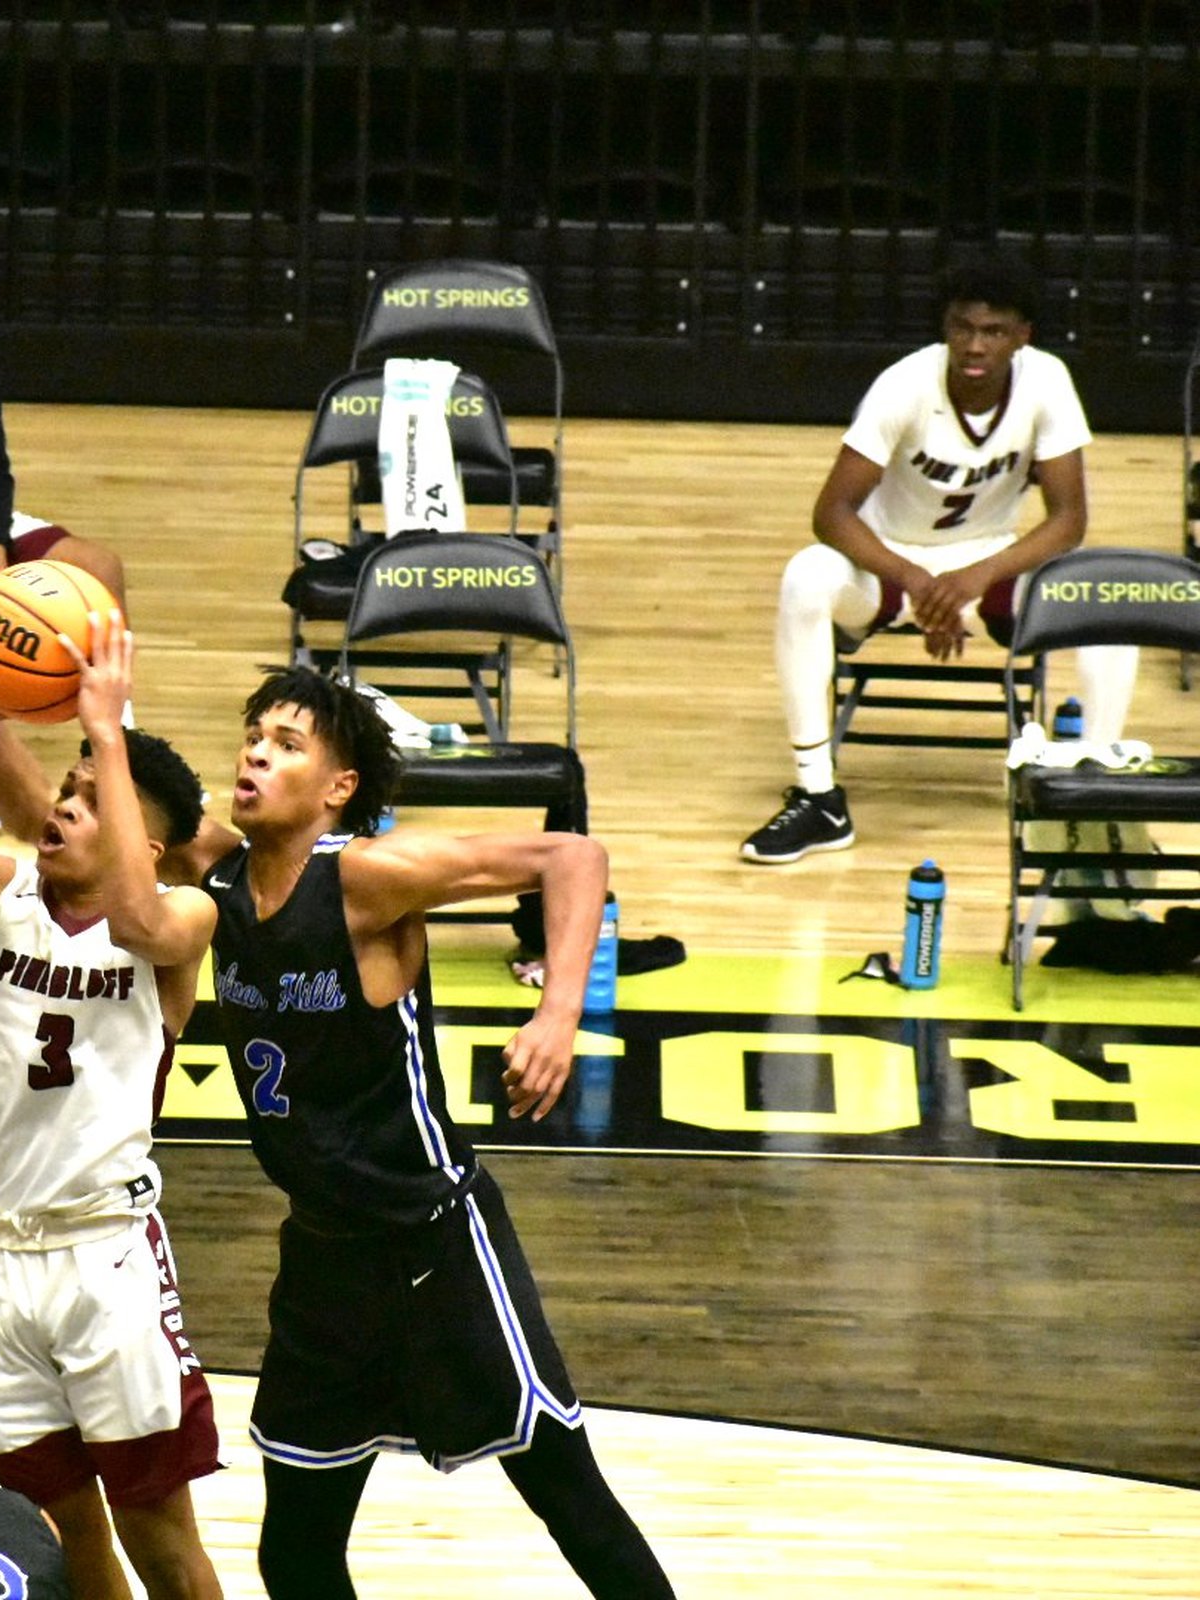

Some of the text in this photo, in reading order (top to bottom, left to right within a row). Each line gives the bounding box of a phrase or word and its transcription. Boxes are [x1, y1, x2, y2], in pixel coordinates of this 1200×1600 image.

[382, 287, 529, 308] HOT SPRINGS
[331, 396, 381, 416] HOT
[375, 566, 537, 589] HOT SPRINGS
[1040, 580, 1200, 603] HOT SPRINGS
[276, 968, 347, 1013] Hills
[27, 1012, 75, 1091] 3
[244, 1038, 290, 1118] 2
